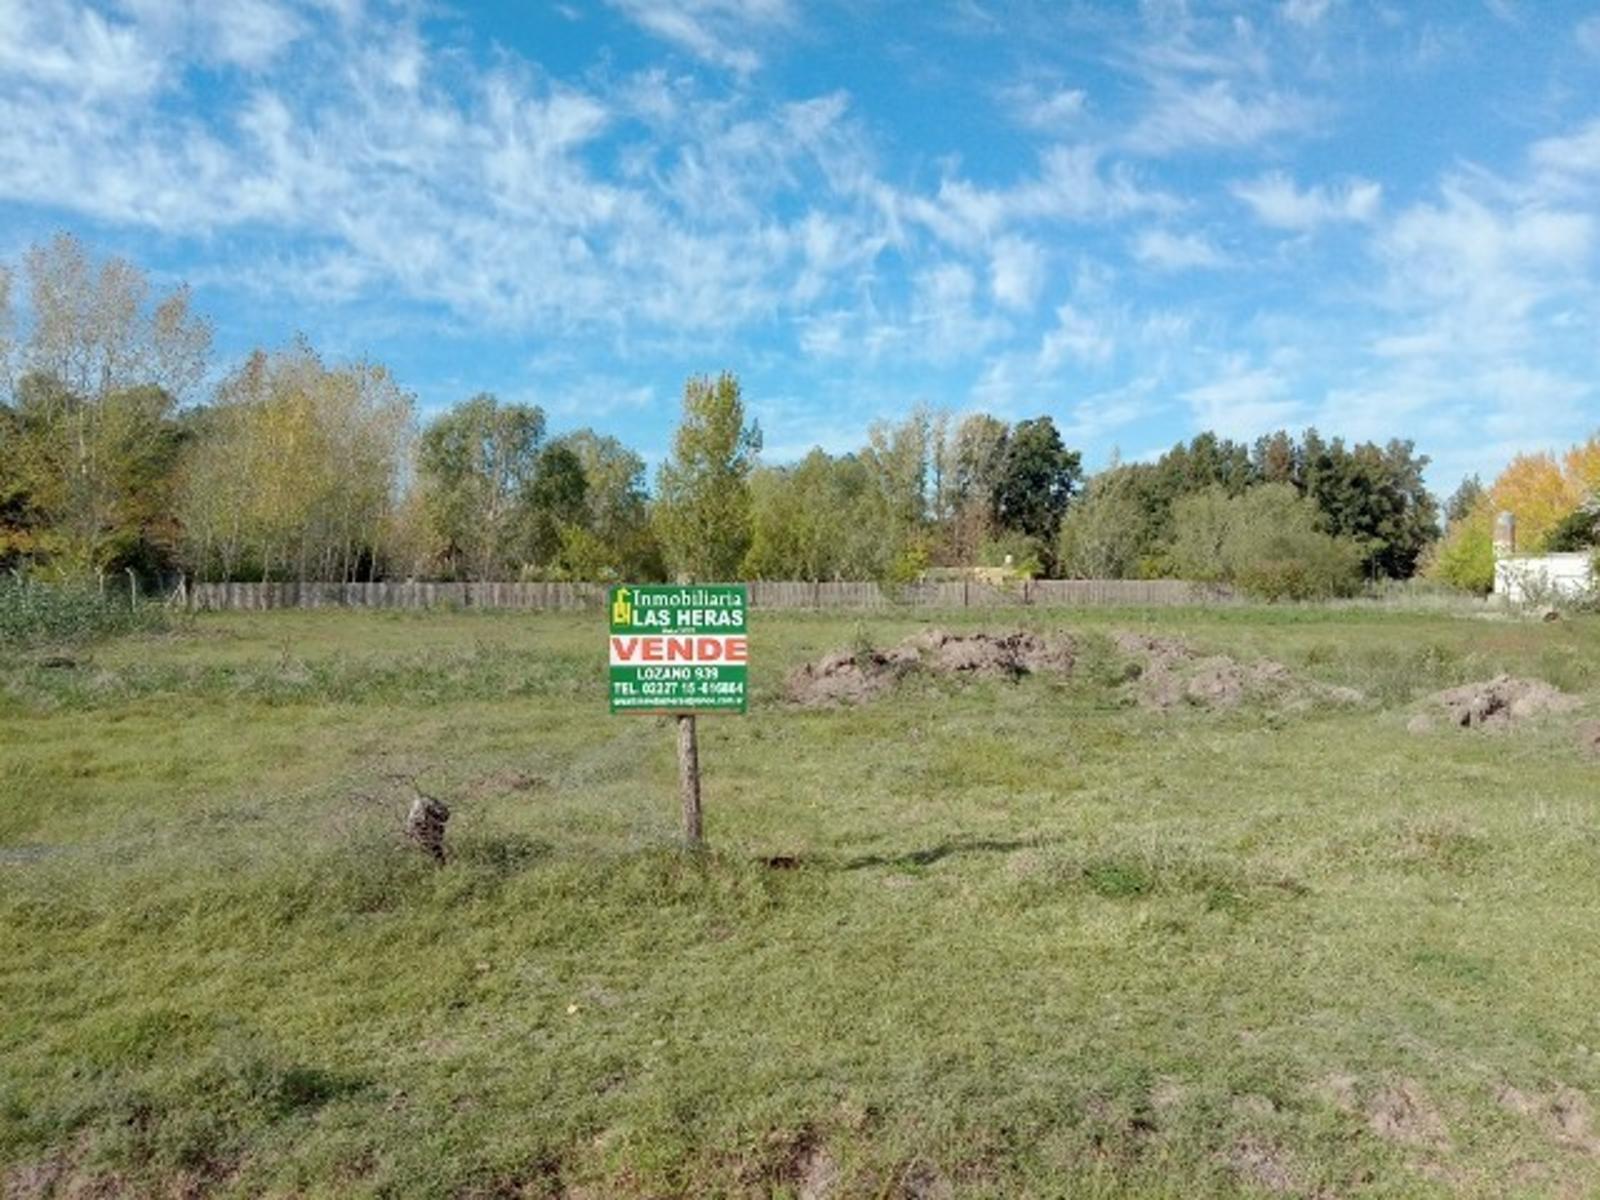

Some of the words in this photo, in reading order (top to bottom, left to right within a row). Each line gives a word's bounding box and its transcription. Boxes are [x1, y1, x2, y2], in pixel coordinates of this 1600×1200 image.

[633, 589, 742, 606] Inmobiliaria
[633, 609, 671, 626] LAS
[677, 609, 744, 626] HERAS
[612, 637, 748, 661] VENDE
[637, 667, 691, 680] LOZANO
